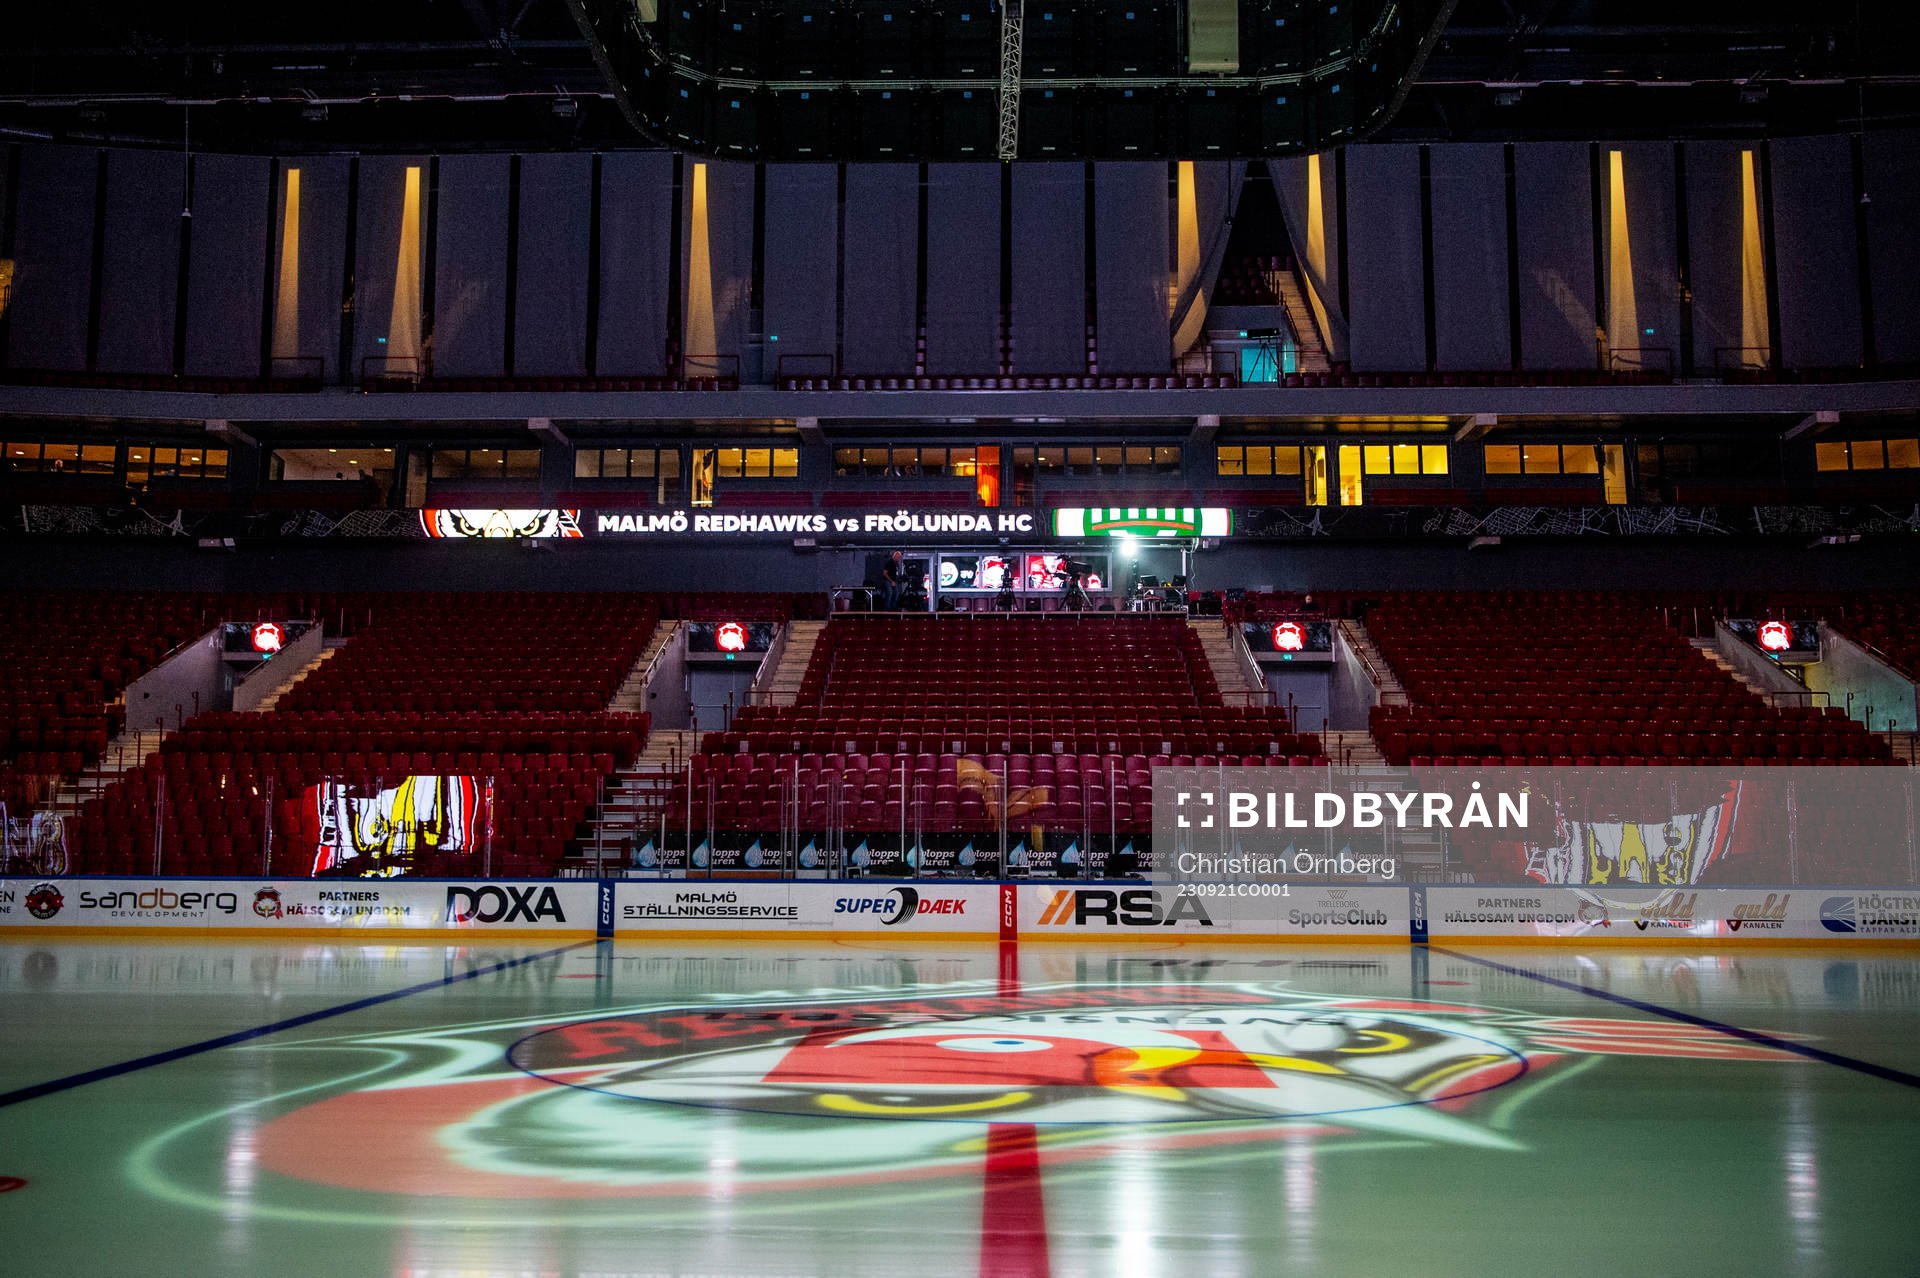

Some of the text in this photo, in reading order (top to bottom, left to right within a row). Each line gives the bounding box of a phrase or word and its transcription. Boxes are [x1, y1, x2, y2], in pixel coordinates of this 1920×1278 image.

[598, 510, 1033, 532] MALMÖ REDHAWKS vs FRÖLUNDA HC
[79, 888, 238, 914] sandberg
[319, 891, 380, 902] PARTNERS
[675, 890, 737, 903] MALMÖ
[1477, 898, 1541, 909] PARTNERS
[286, 903, 411, 916] HÄLSOSAM UNGDOM
[446, 886, 567, 923] DOXA
[602, 887, 611, 925] CCM
[623, 903, 799, 917] STÄLLNINGSSERVICE
[834, 897, 897, 914] SUPER
[1004, 889, 1012, 928] CCM
[1075, 889, 1215, 927] RSA
[1317, 899, 1360, 909] TRELLEBORG
[1414, 891, 1423, 931] CCM
[111, 911, 205, 919] DEVELOPMENT
[1288, 908, 1388, 928] SportsClub
[1444, 912, 1576, 924] HÄLSOSAM UNGDOM
[1650, 921, 1690, 930] KANALEN
[1743, 921, 1783, 930] KANALEN
